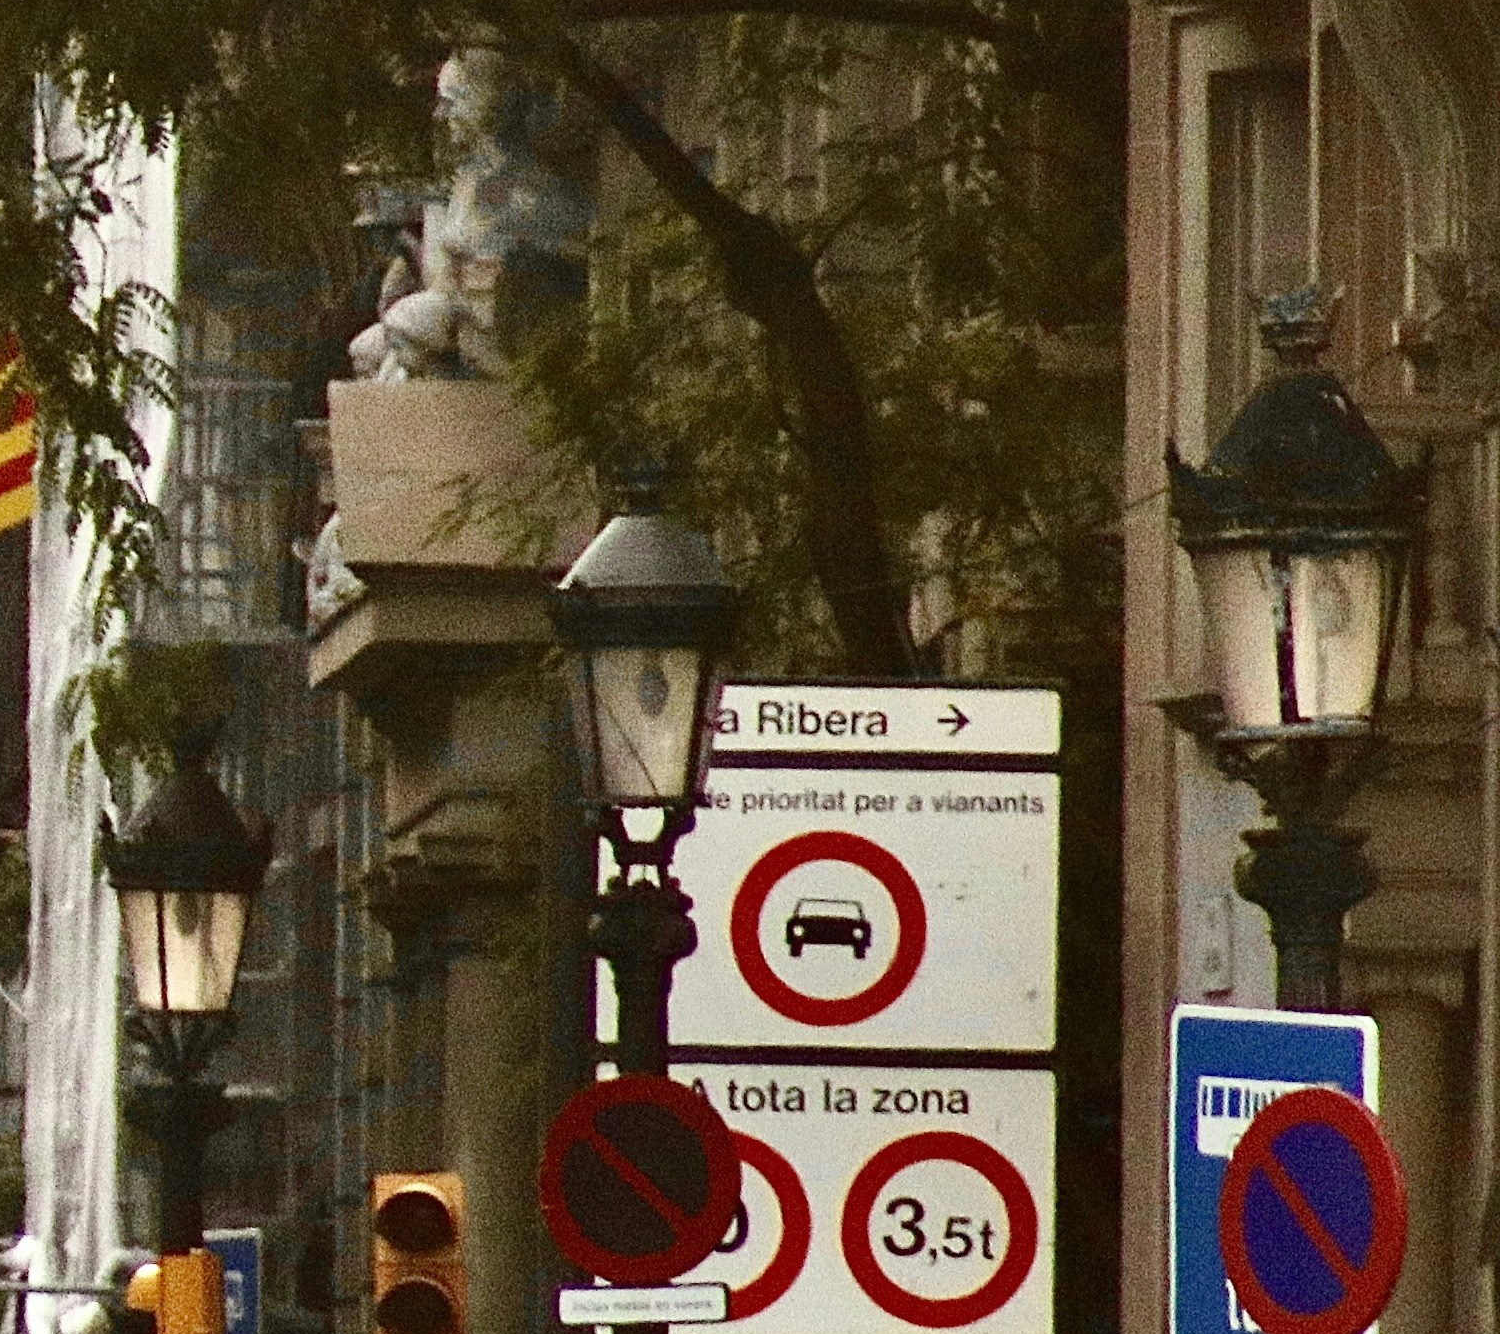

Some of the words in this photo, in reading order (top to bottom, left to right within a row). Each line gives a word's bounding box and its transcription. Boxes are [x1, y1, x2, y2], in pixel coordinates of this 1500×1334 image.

[757, 700, 888, 736] Ribera
[740, 789, 846, 815] prioritat
[854, 793, 898, 816] per
[905, 793, 924, 812] a
[931, 789, 1046, 815] vianants
[727, 1078, 805, 1112] tota
[822, 1078, 858, 1113] la
[872, 1088, 969, 1114] zona
[882, 1196, 995, 1265] 3,5t
